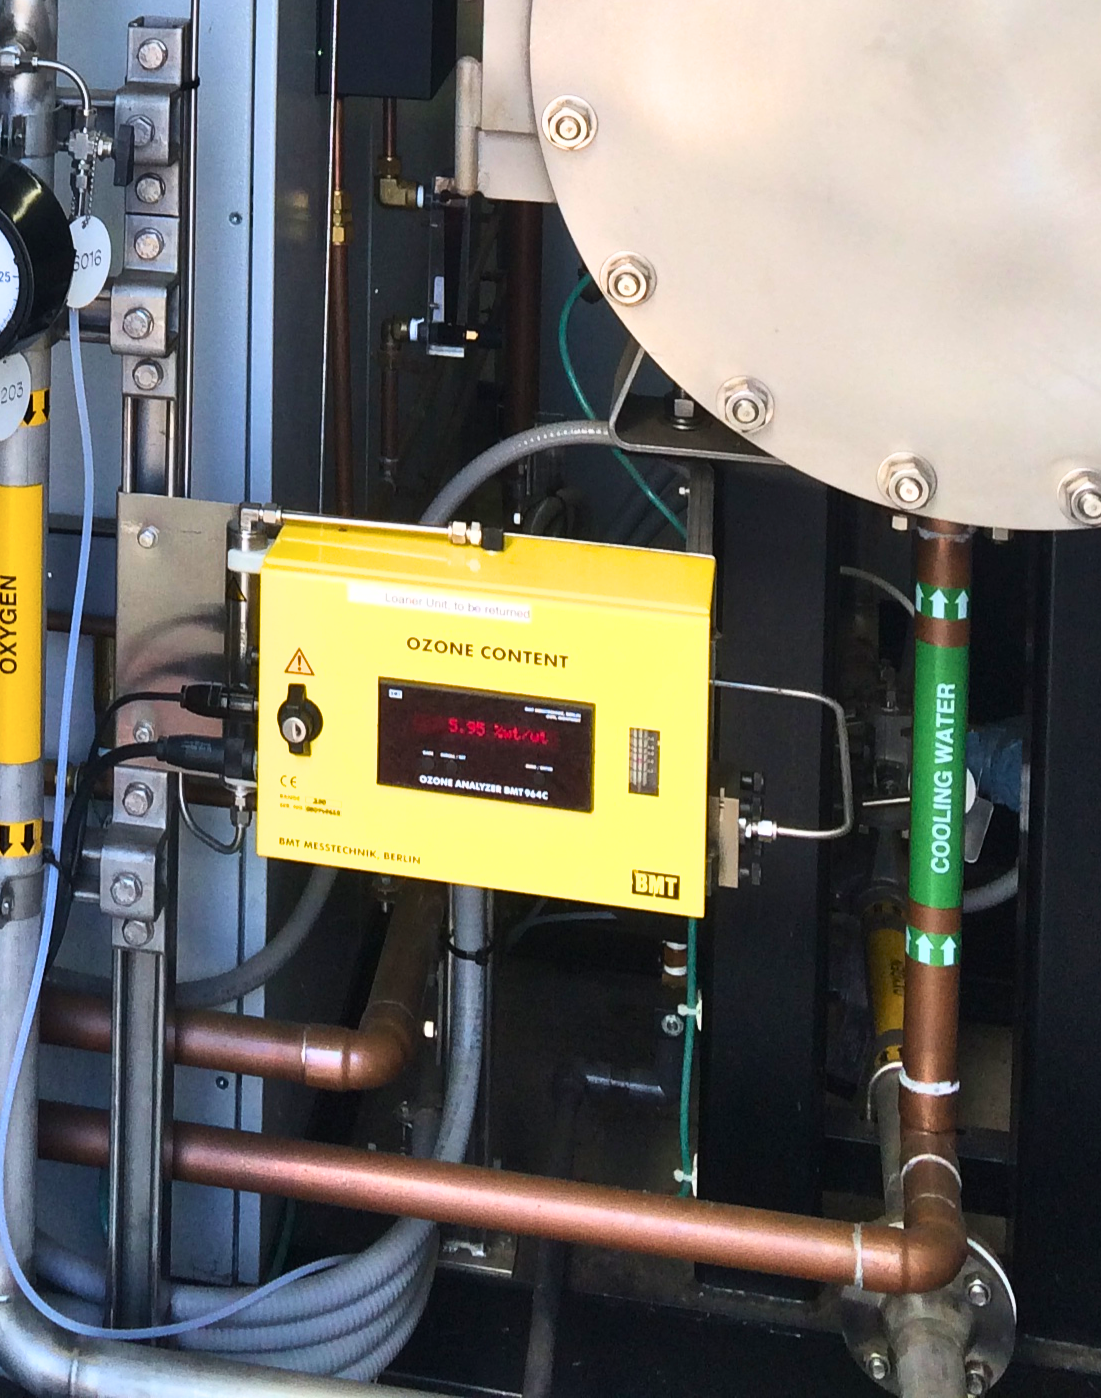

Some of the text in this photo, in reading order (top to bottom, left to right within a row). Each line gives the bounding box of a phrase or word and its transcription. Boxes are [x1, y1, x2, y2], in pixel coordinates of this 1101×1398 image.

[384, 591, 423, 607] Loaner
[454, 599, 465, 611] to
[467, 600, 481, 613] be
[484, 604, 531, 620] returned
[0, 575, 17, 675] OXYGEN
[406, 636, 569, 669] OZONE CONTENT
[448, 717, 486, 737] 5.95
[419, 774, 549, 801] OZONE ANALYZER BMT 964C
[930, 683, 956, 875] COOLING WATER
[278, 837, 421, 865] BMT MESSTECHNIK, BERLIN
[634, 872, 678, 897] BMT
